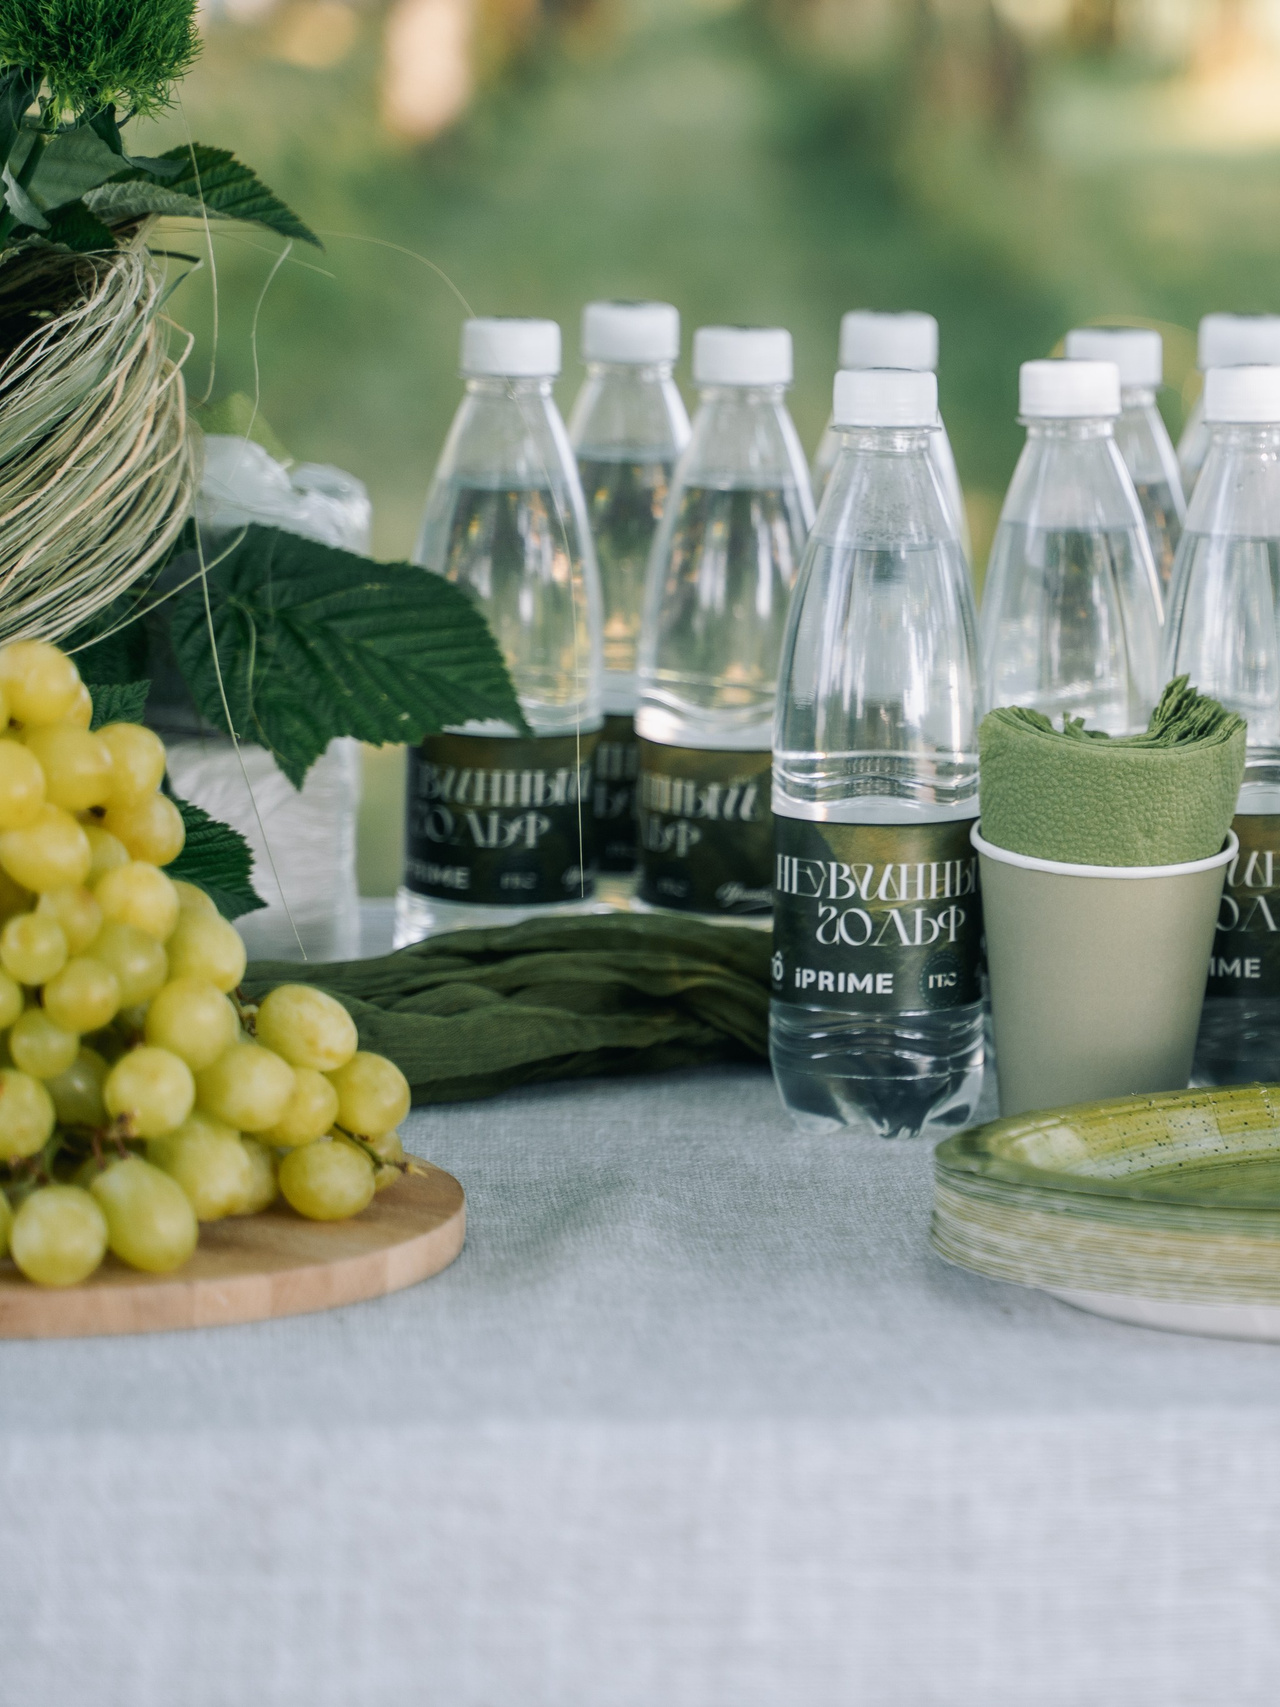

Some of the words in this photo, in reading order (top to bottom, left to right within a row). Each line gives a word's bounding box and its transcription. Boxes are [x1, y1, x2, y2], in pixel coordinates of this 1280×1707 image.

[416, 763, 592, 808] ВИННЫЙ
[410, 803, 551, 849] ОЛЬФ
[776, 853, 979, 902] НЕВИННЫ
[794, 967, 894, 995] iPRIME
[1210, 957, 1262, 979] IME
